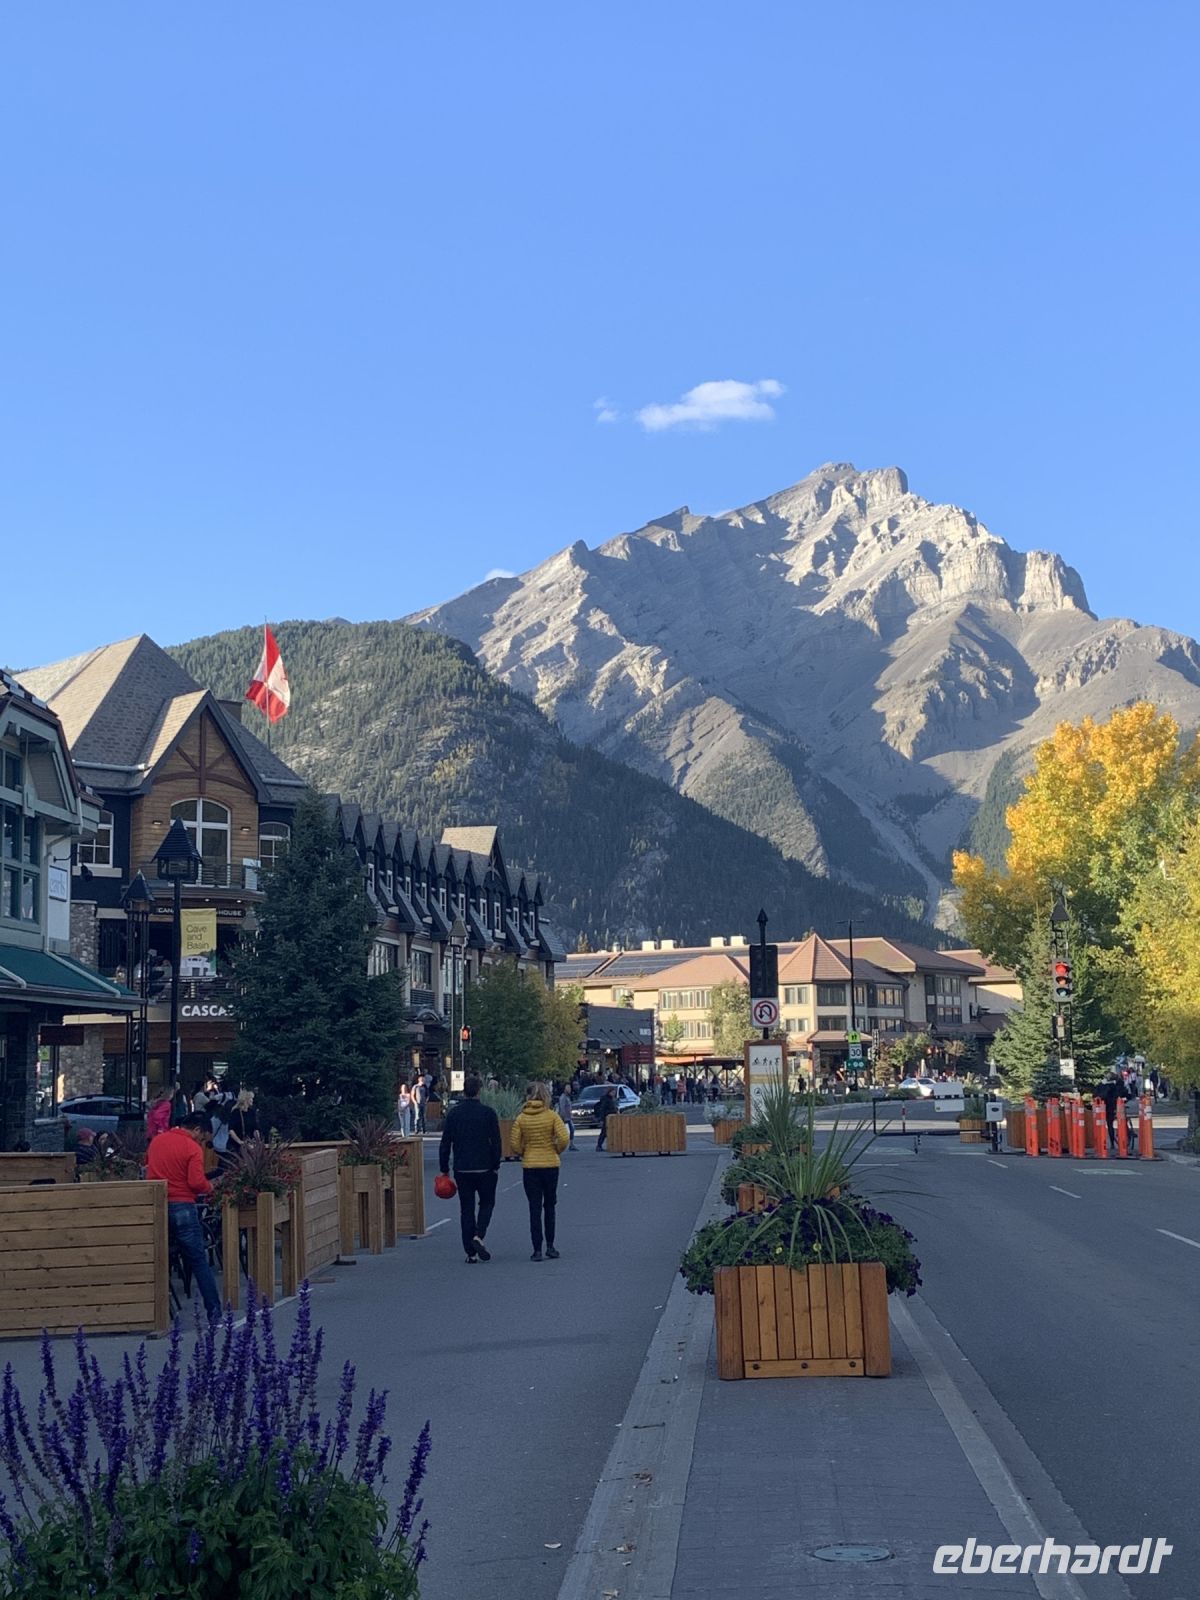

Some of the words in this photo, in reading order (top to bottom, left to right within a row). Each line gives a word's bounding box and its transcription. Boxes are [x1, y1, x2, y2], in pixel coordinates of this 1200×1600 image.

[186, 924, 207, 933] Cave
[186, 933, 203, 941] and
[186, 941, 210, 950] Basin
[850, 1048, 862, 1057] 30
